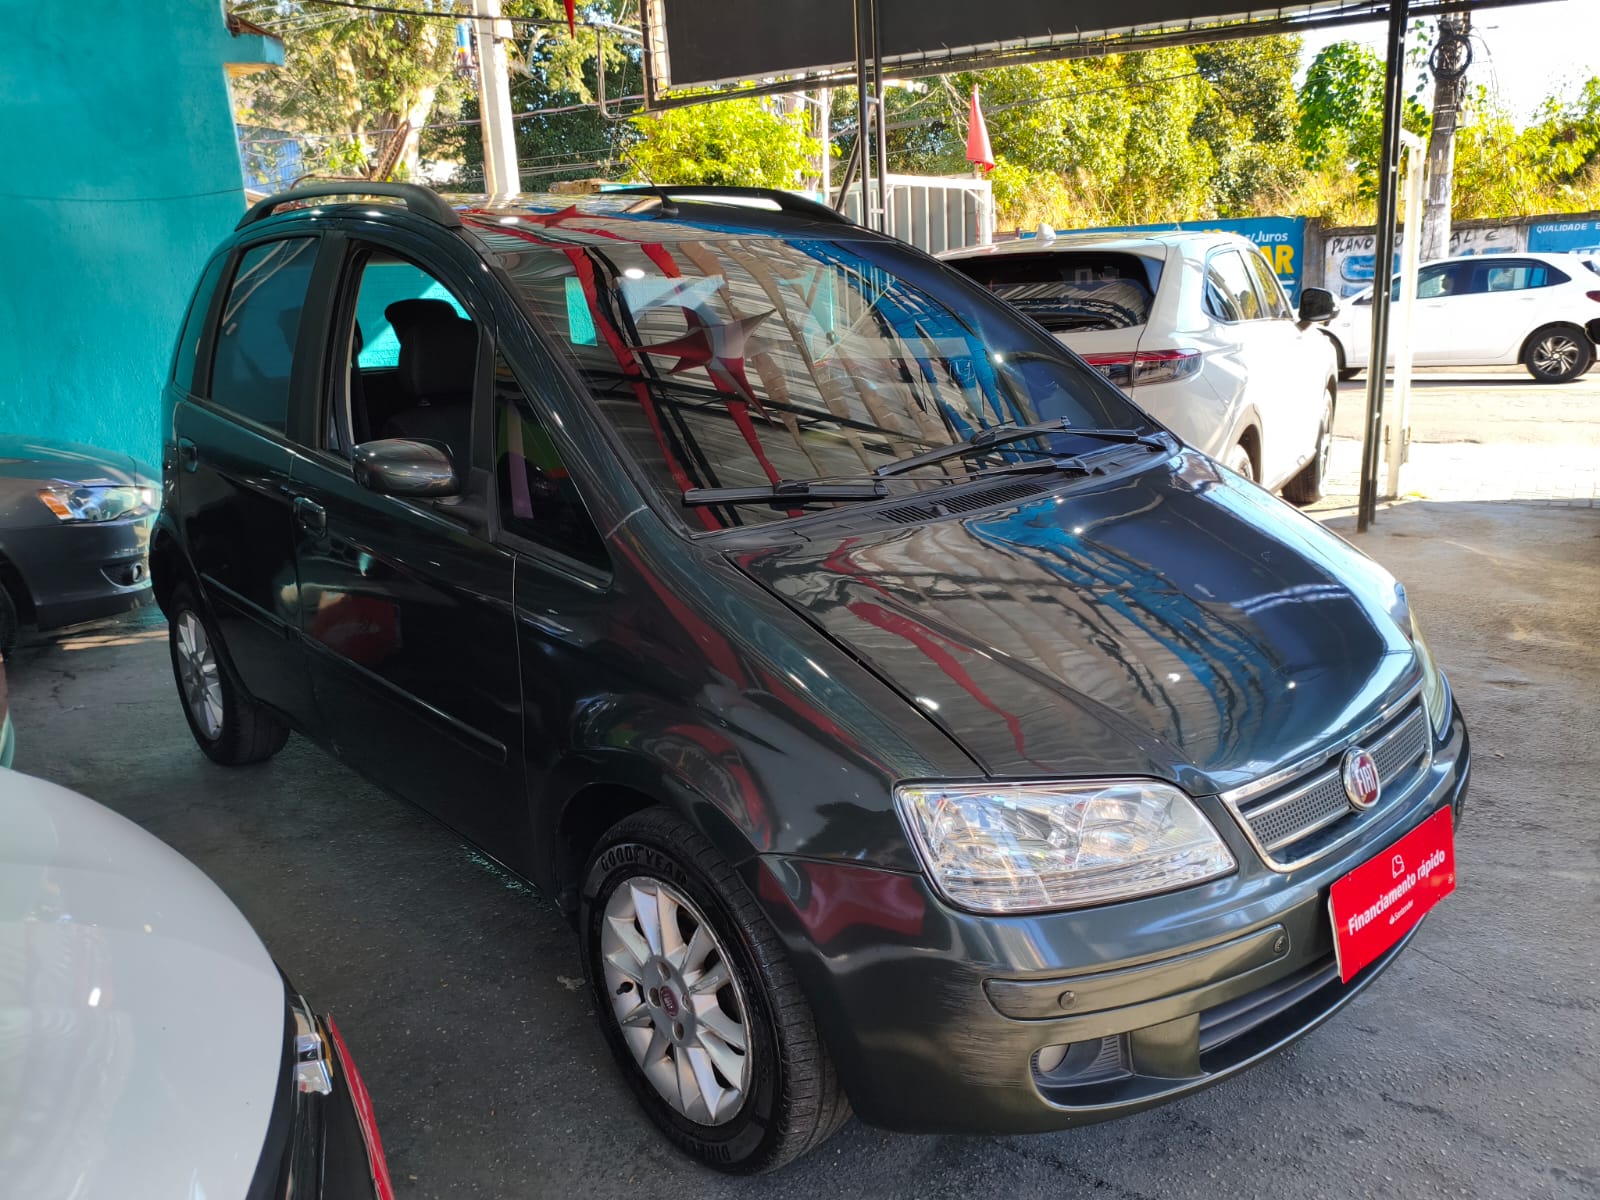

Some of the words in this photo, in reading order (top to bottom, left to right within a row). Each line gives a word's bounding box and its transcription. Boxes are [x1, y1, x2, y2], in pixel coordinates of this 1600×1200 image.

[1536, 223, 1588, 234] QUALIDADE
[1331, 236, 1374, 256] PLANO
[1347, 872, 1417, 936] Financiamento
[1417, 848, 1446, 880] rápido
